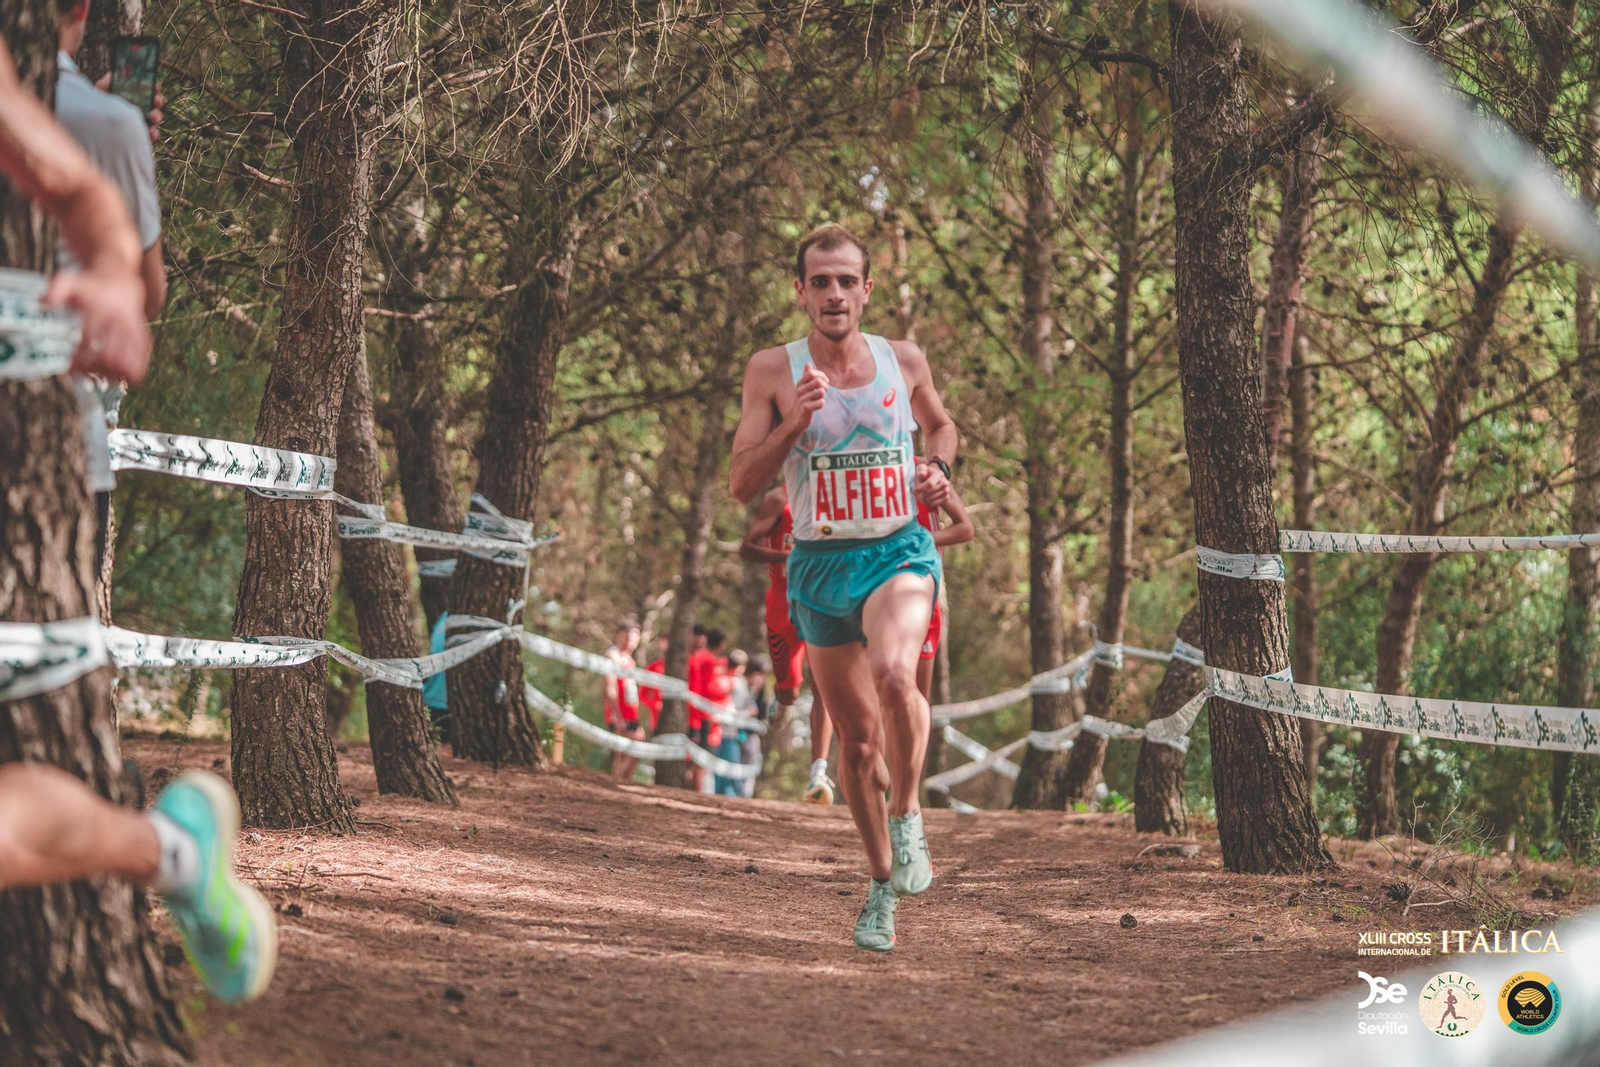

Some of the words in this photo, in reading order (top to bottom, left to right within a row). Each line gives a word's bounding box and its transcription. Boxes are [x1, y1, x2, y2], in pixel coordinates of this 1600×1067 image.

[836, 452, 882, 467] ITÁLICA
[815, 466, 909, 522] ALFIERI
[348, 526, 381, 535] Sevilla
